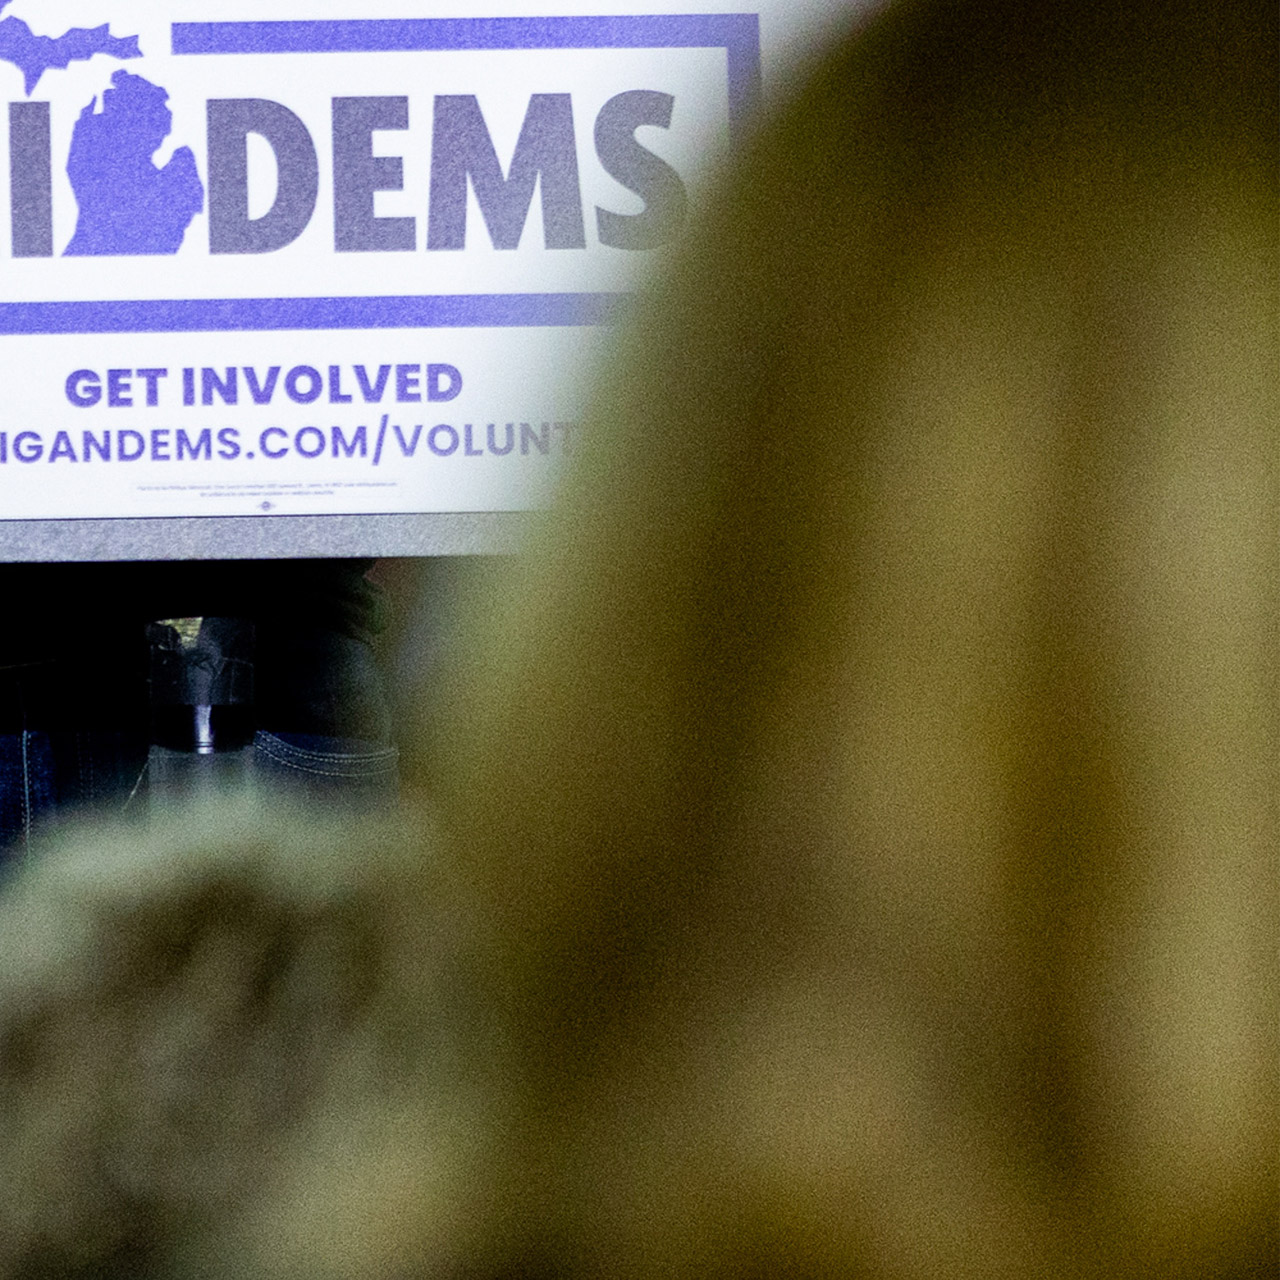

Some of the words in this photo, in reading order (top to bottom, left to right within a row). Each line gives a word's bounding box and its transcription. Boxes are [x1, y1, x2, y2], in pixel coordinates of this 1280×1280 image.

[206, 88, 692, 255] DEMS
[64, 367, 168, 409] GET
[180, 360, 464, 407] INVOLVED
